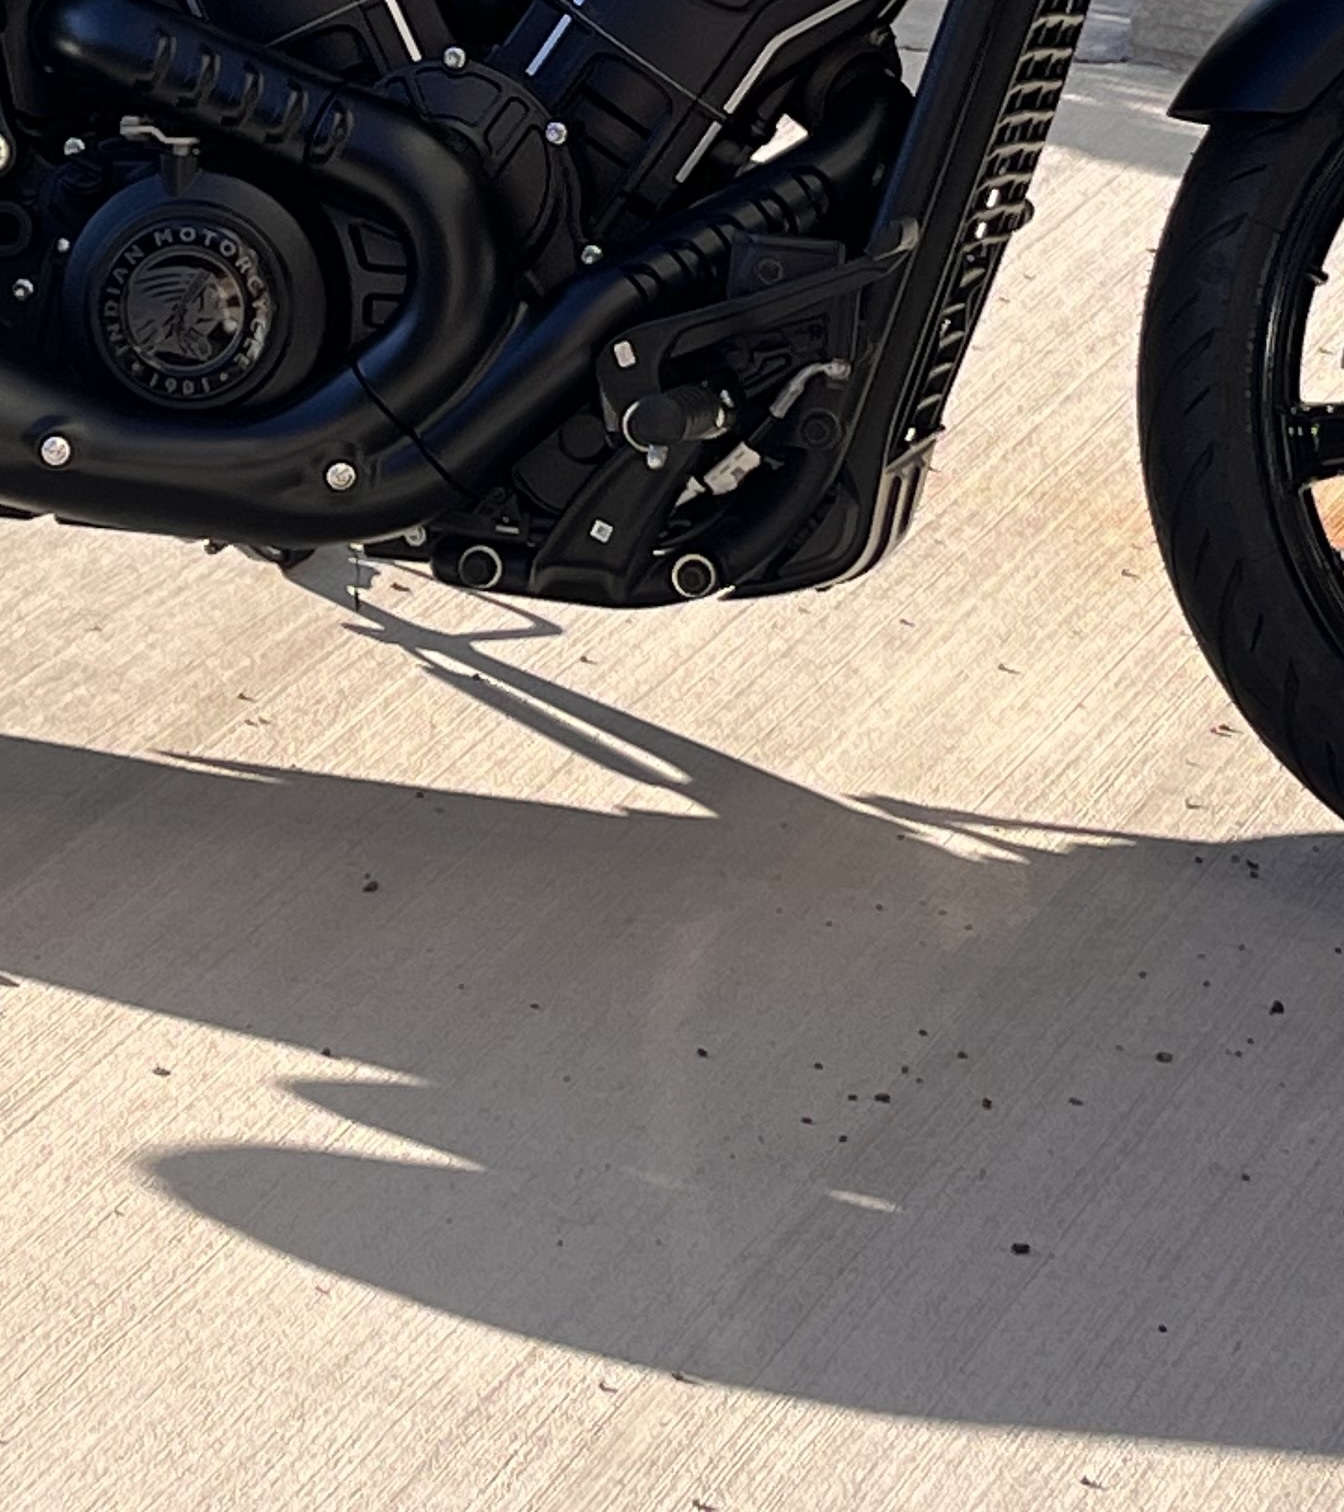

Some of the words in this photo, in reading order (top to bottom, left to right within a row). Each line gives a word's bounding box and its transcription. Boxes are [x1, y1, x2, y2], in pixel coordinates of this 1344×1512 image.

[102, 244, 145, 357] INDIAN
[153, 226, 270, 370] MOTORCYCLE
[148, 373, 211, 395] 1901
